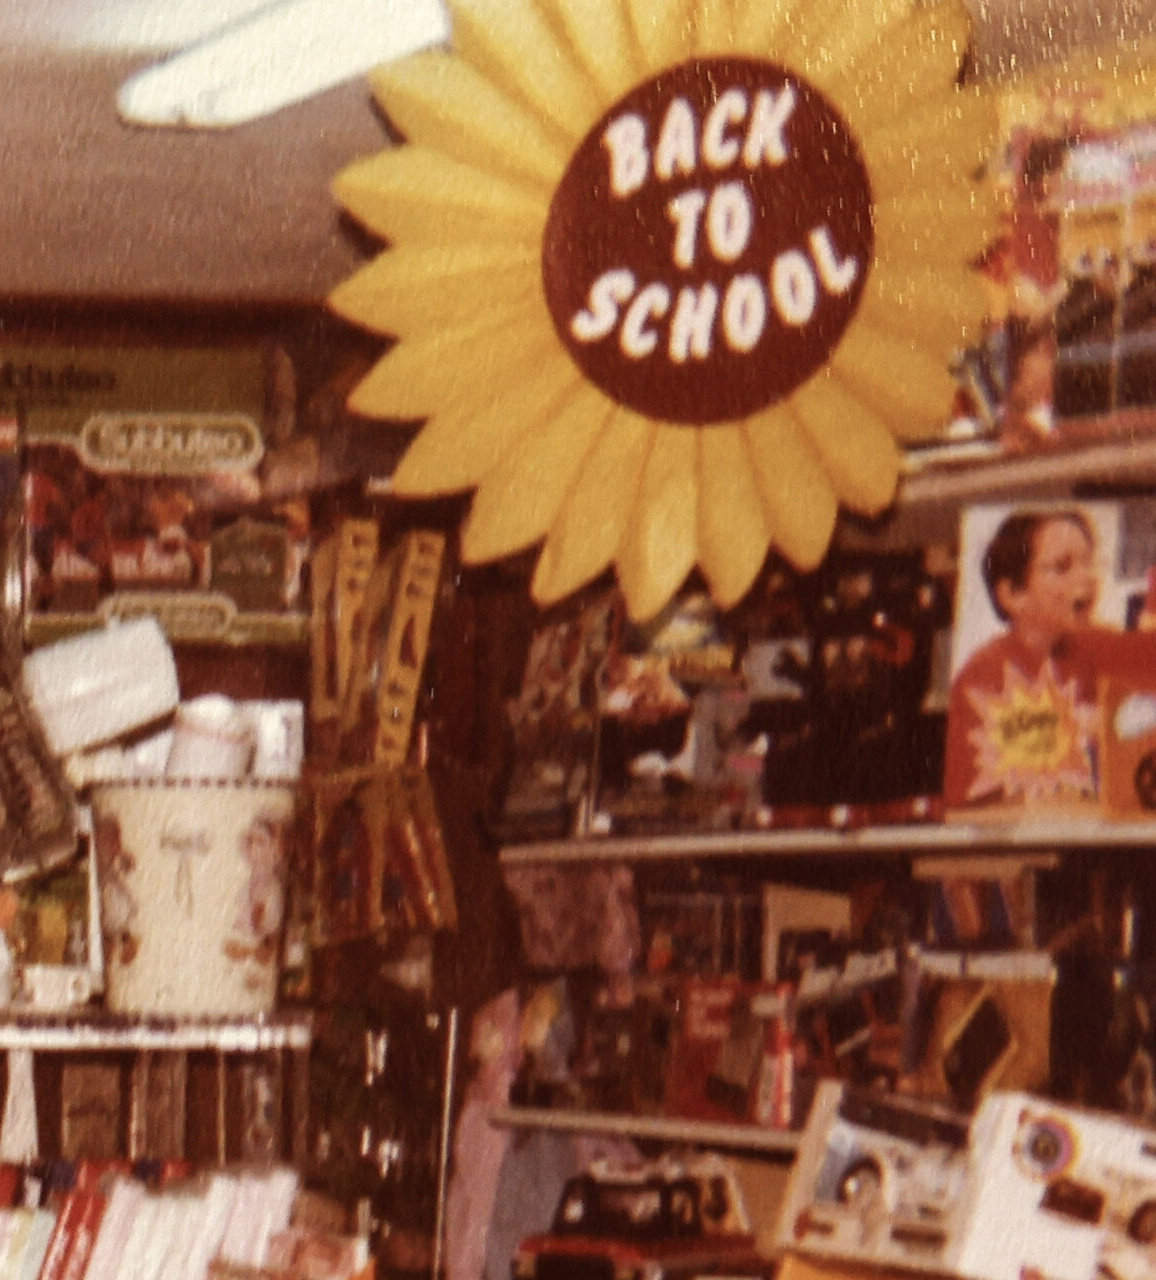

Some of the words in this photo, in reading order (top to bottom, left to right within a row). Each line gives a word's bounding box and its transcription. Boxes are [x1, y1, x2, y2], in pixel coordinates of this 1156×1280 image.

[602, 86, 795, 198] BACK
[667, 178, 752, 270] TO
[571, 223, 858, 365] SCHOOL
[100, 417, 243, 455] Subbuteo
